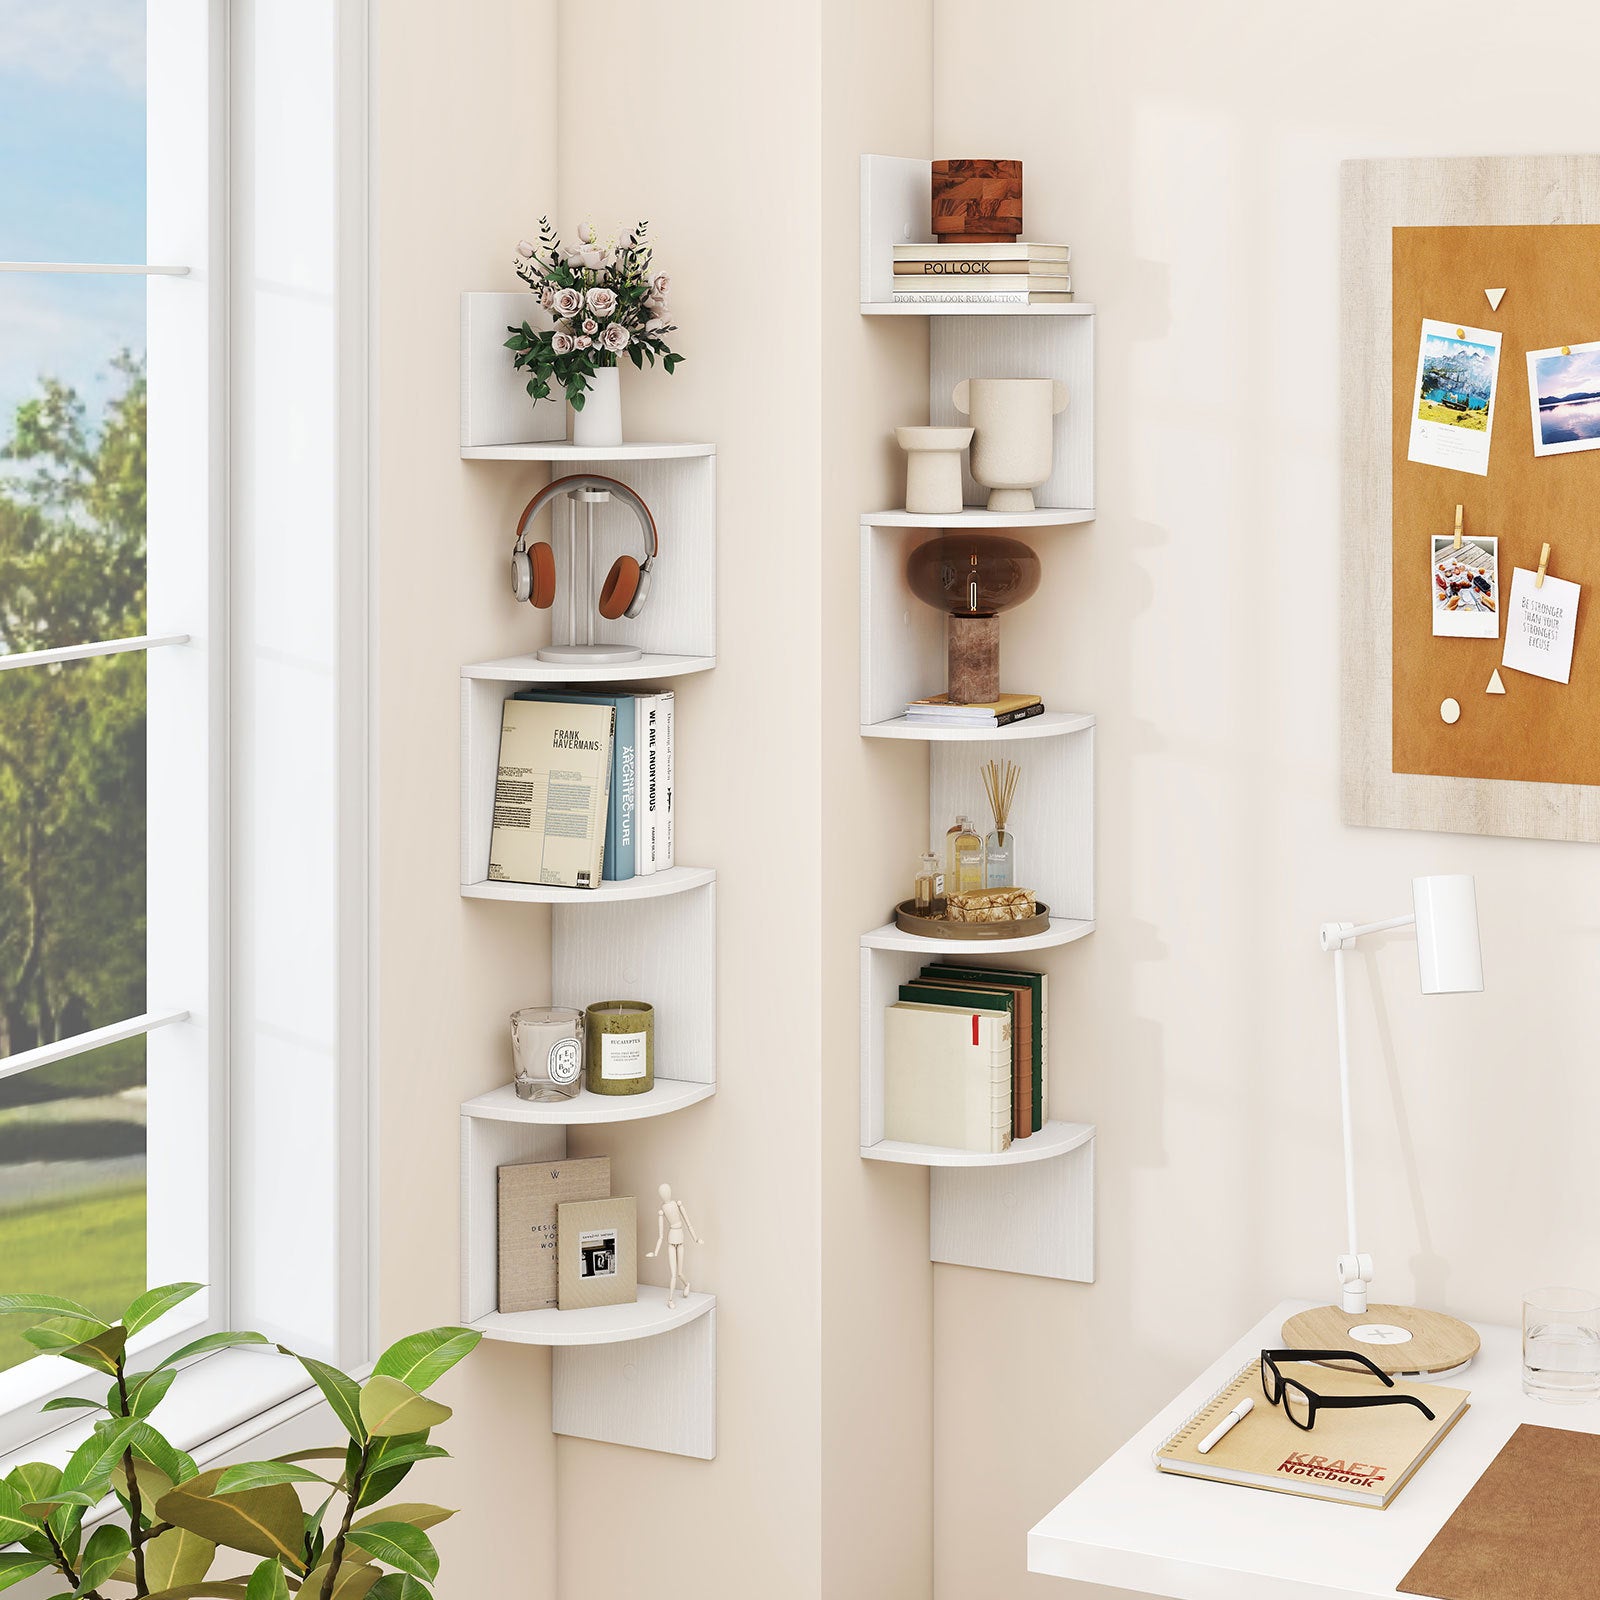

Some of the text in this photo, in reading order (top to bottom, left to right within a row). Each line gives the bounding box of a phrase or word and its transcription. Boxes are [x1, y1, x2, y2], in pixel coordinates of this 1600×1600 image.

[924, 262, 990, 274] POLLOCK
[919, 295, 938, 303] NEW
[940, 295, 963, 303] LOOK
[966, 295, 1021, 303] REVOLUTION
[1521, 596, 1563, 618] BE STRONGER
[1524, 610, 1560, 630] THAN YOUR
[1523, 622, 1558, 640] STRONGEST
[1528, 635, 1551, 652] EXCUSE
[649, 710, 656, 726] WE
[554, 729, 580, 740] FRANK
[553, 739, 603, 751] HAVERMANS:
[622, 746, 630, 846] ARCHITECTURE
[1284, 1451, 1388, 1478] KRAFT
[1277, 1463, 1375, 1488] Notebook
